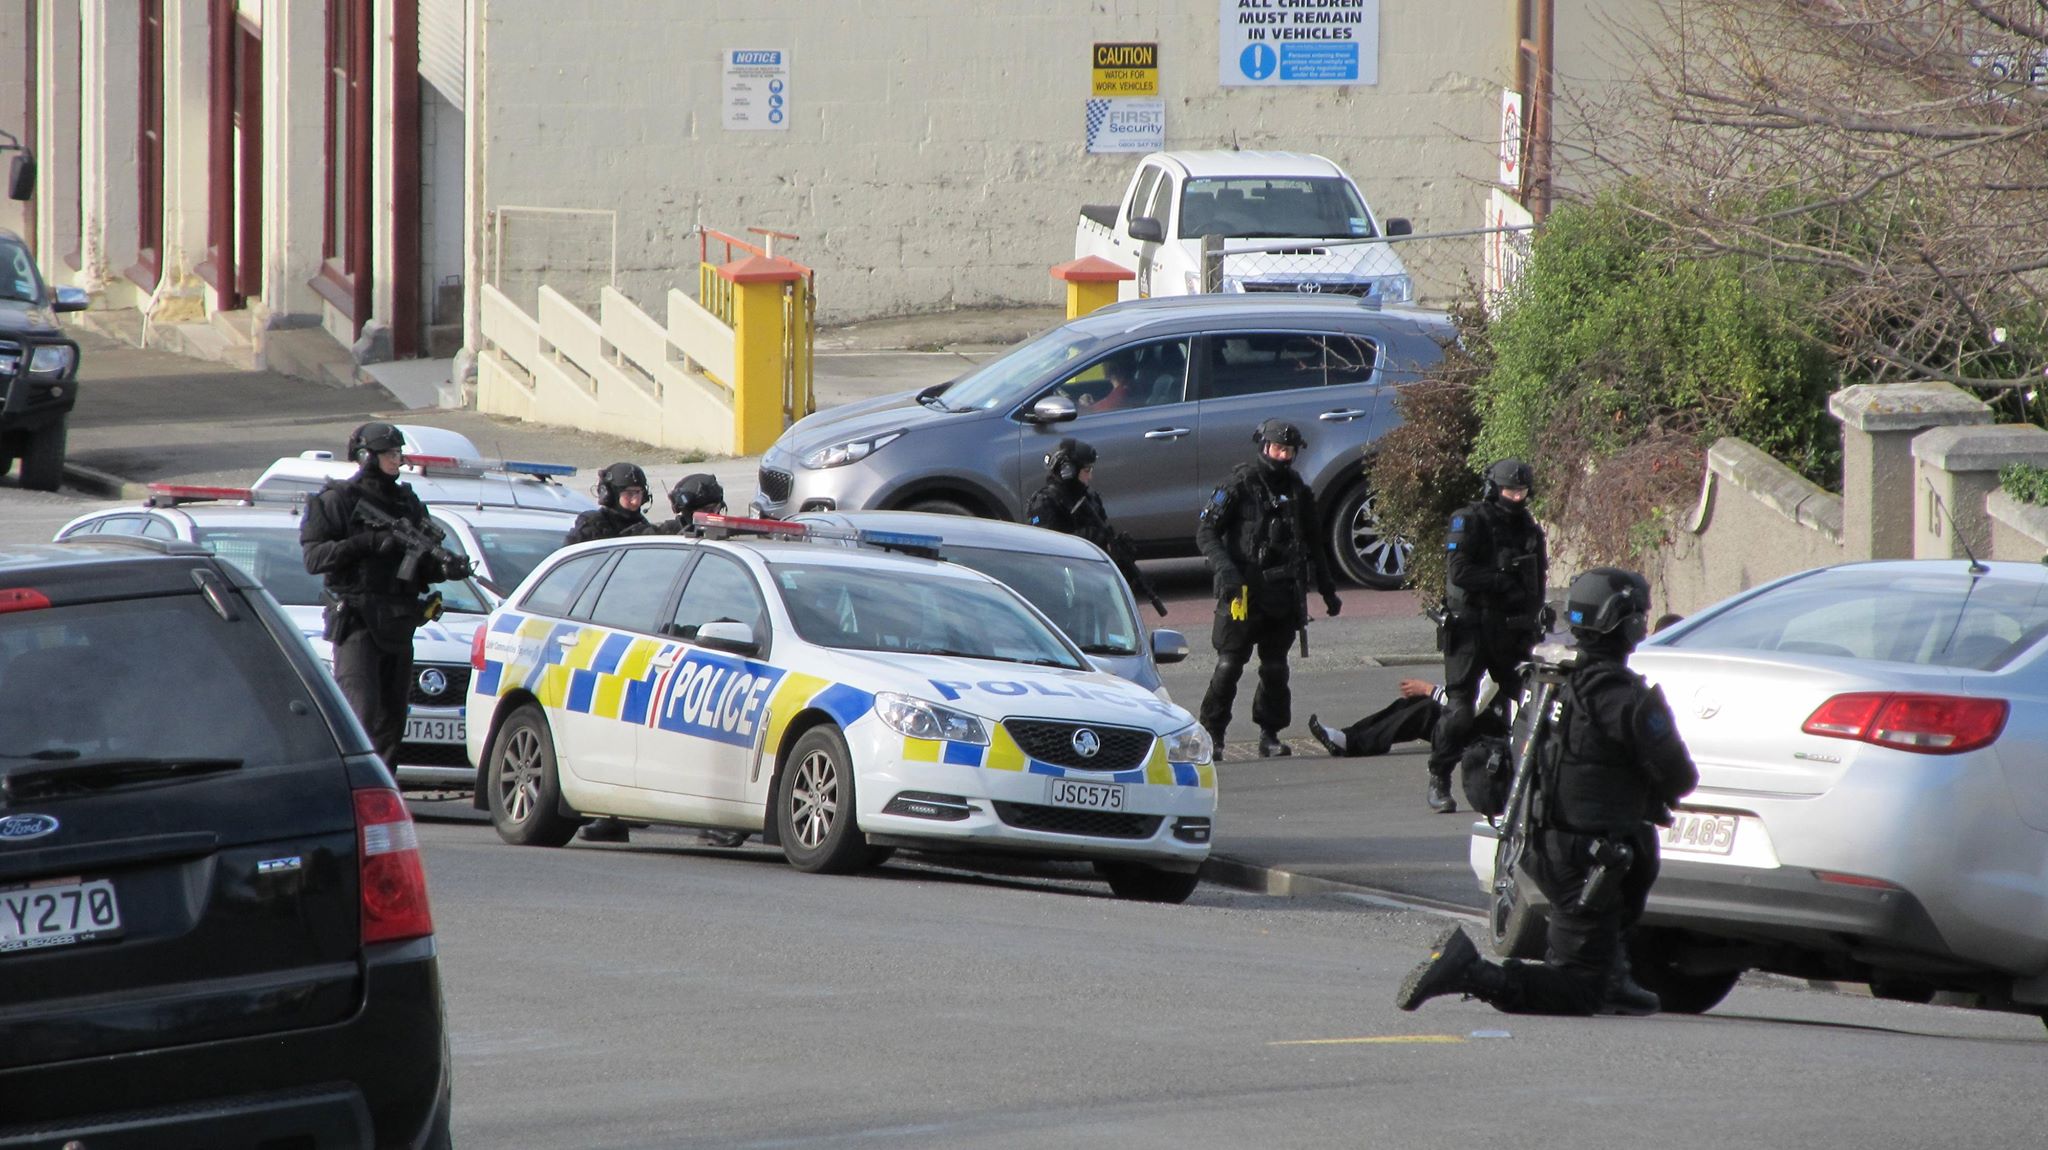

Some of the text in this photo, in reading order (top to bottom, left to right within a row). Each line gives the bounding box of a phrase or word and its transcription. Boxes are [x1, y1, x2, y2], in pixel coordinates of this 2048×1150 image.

[1238, 0, 1363, 8] ALL CHILDREN
[1238, 11, 1362, 24] MUST REMAIN
[1248, 27, 1353, 40] IN VEHICLES
[736, 52, 777, 63] NOTICE
[1098, 47, 1152, 65] CAUTION
[1105, 70, 1145, 79] WATCH FOR
[1096, 81, 1153, 91] WORK VEHICLES
[1110, 111, 1162, 123] FIRST
[1110, 123, 1162, 134] Security
[666, 661, 772, 736] POLICE
[928, 678, 1183, 721] POLICE
[1054, 783, 1121, 808] JSC575
[3, 818, 42, 835] Ford
